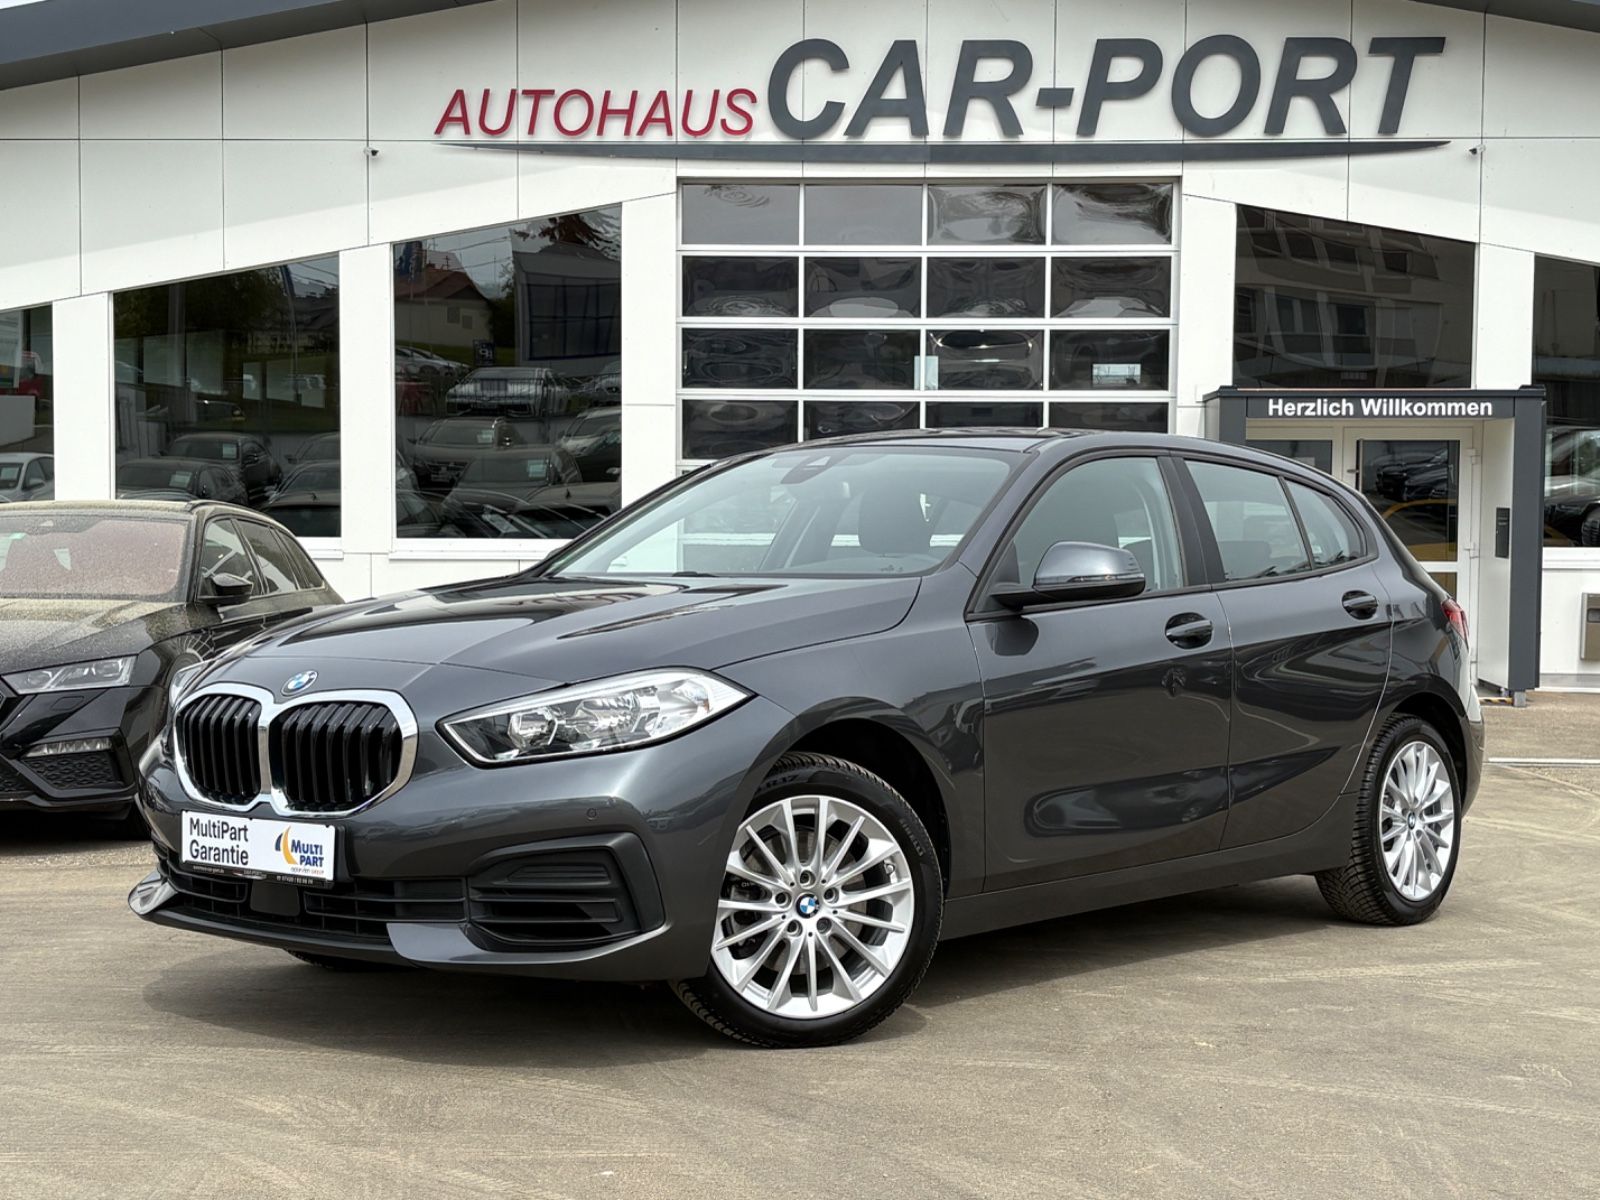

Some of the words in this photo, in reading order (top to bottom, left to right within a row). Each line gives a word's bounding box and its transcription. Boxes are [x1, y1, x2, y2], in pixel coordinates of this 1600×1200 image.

[433, 88, 758, 137] AUTOHAUS
[766, 34, 1446, 139] CAR-PORT
[1267, 398, 1354, 417] Herzlich
[1360, 398, 1493, 417] Willkommen
[189, 817, 249, 842] MultiPart
[189, 840, 249, 866] Garantie
[291, 839, 323, 856] MULTI
[299, 855, 325, 868] PART
